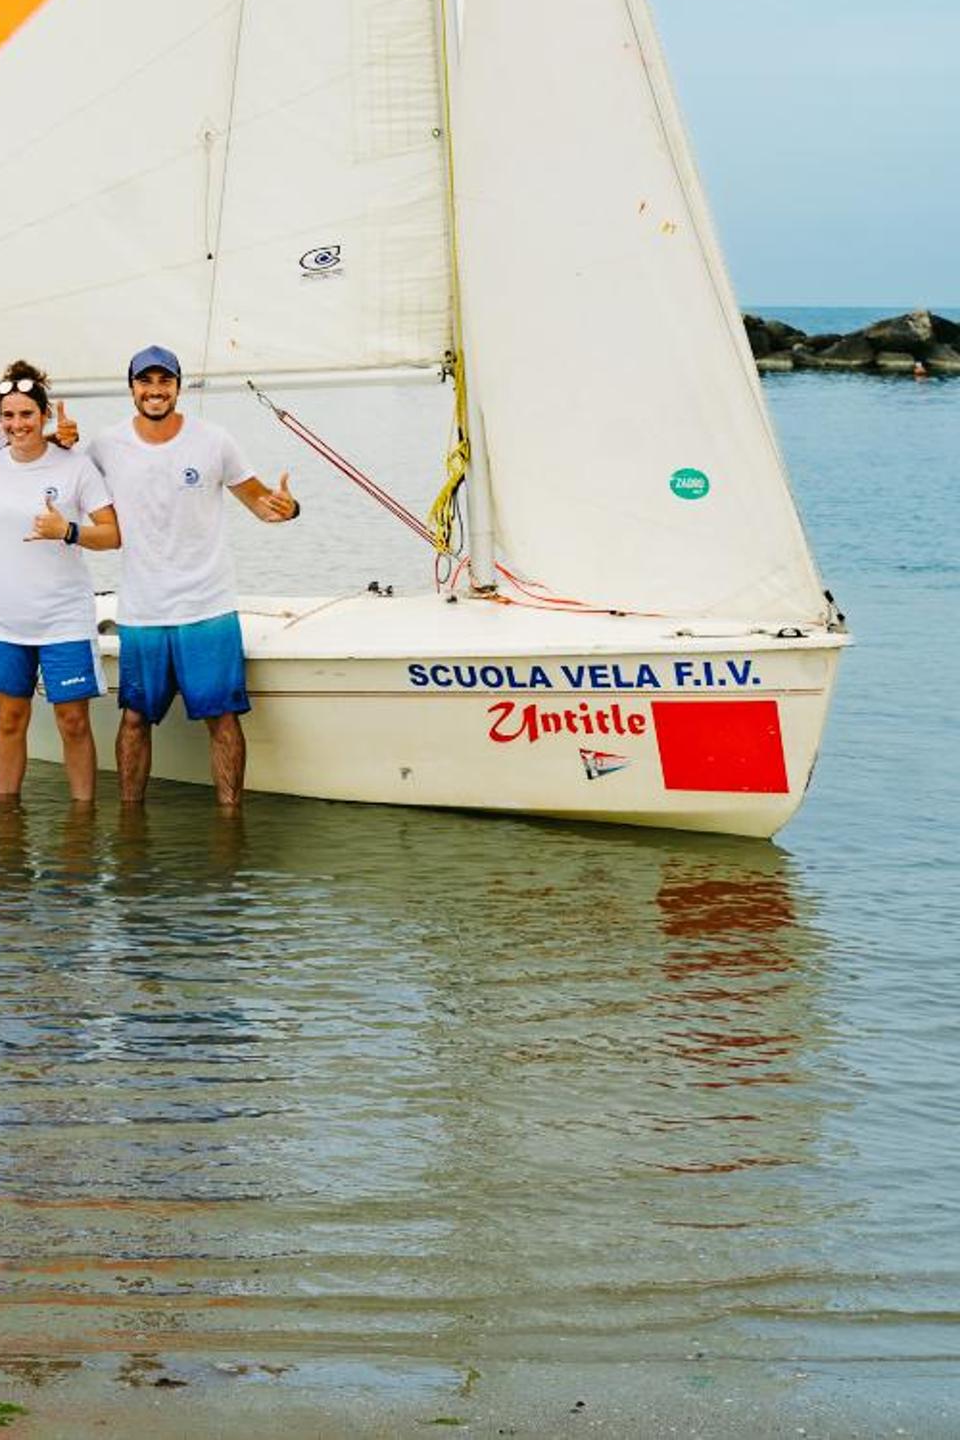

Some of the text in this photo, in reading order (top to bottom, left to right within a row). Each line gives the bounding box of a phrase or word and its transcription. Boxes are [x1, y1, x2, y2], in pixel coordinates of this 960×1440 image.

[408, 660, 761, 688] SCUOLA VELA F.I.V.
[488, 701, 646, 743] Untitle
